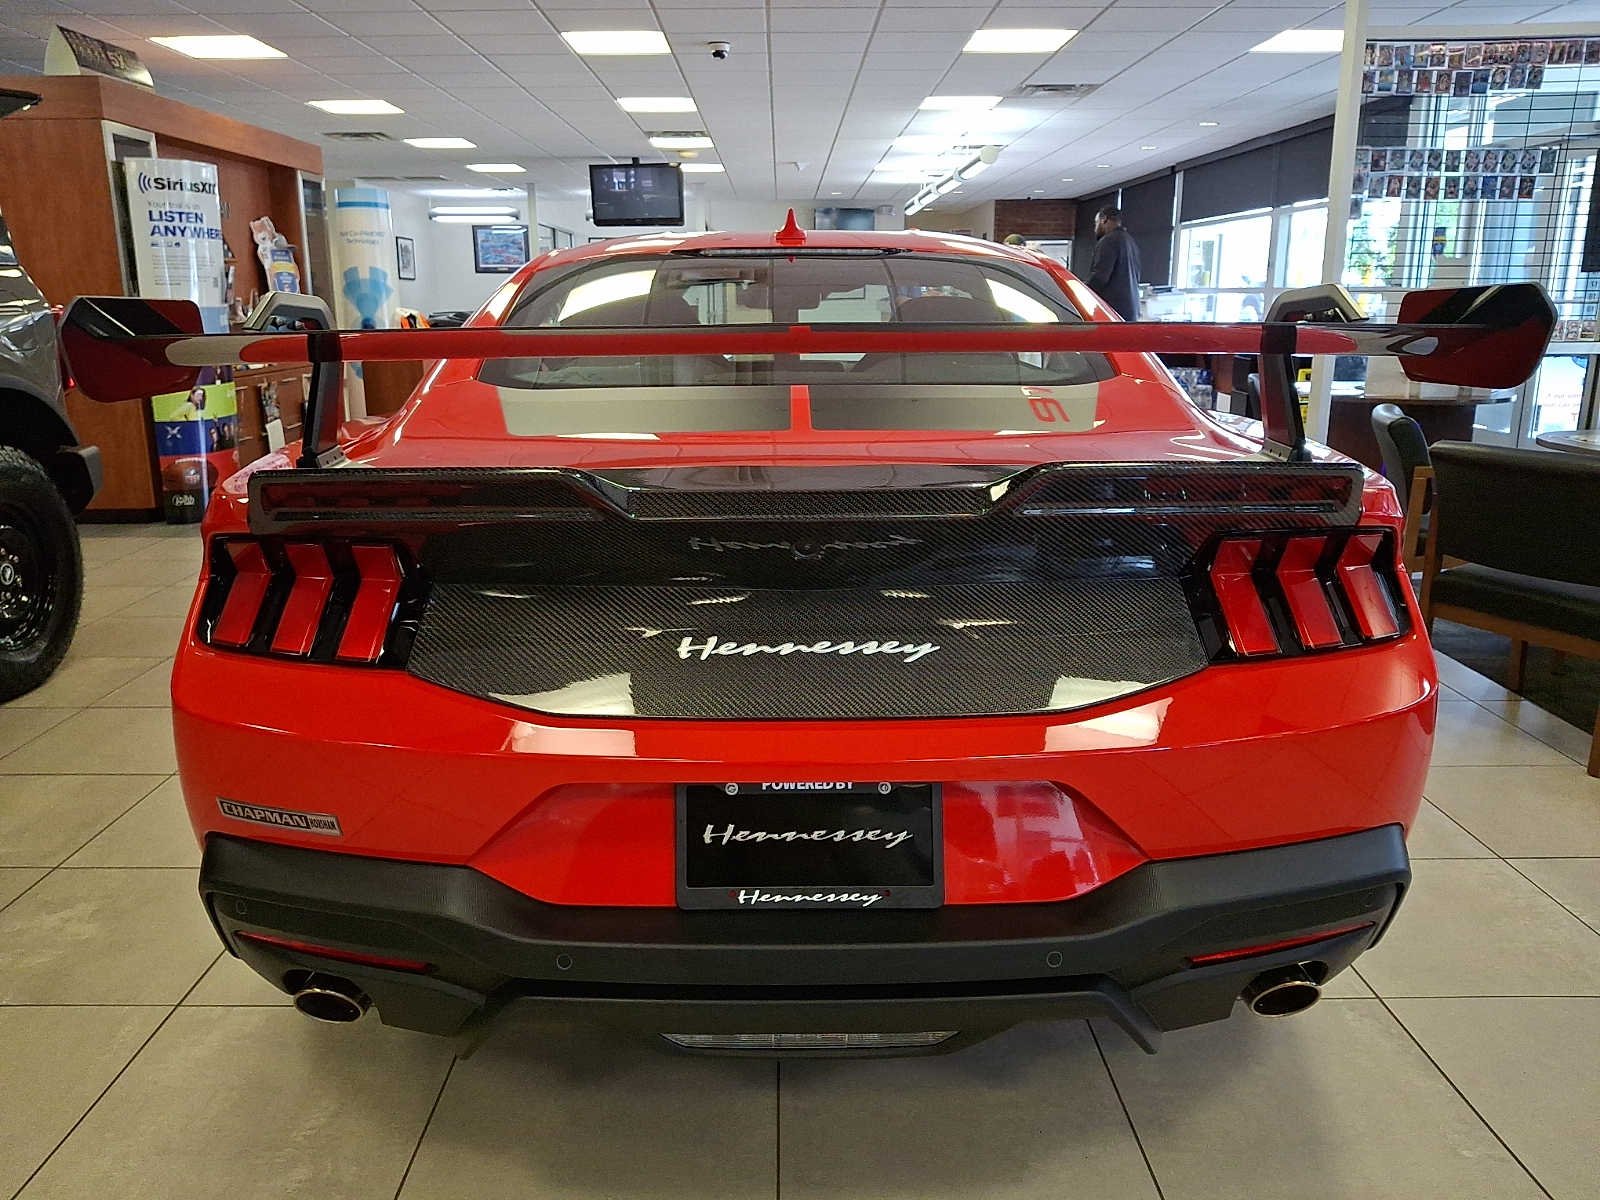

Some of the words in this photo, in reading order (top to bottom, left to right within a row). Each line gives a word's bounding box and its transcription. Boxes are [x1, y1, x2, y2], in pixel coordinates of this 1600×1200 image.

[148, 210, 204, 224] LISTEN
[150, 225, 222, 240] ANYWHER
[677, 635, 941, 663] Hennessey
[761, 782, 834, 790] POWERED
[836, 782, 854, 790] BY
[221, 802, 308, 828] CHAPMAN
[703, 823, 913, 848] Hennessey
[737, 889, 883, 907] Hennessey
